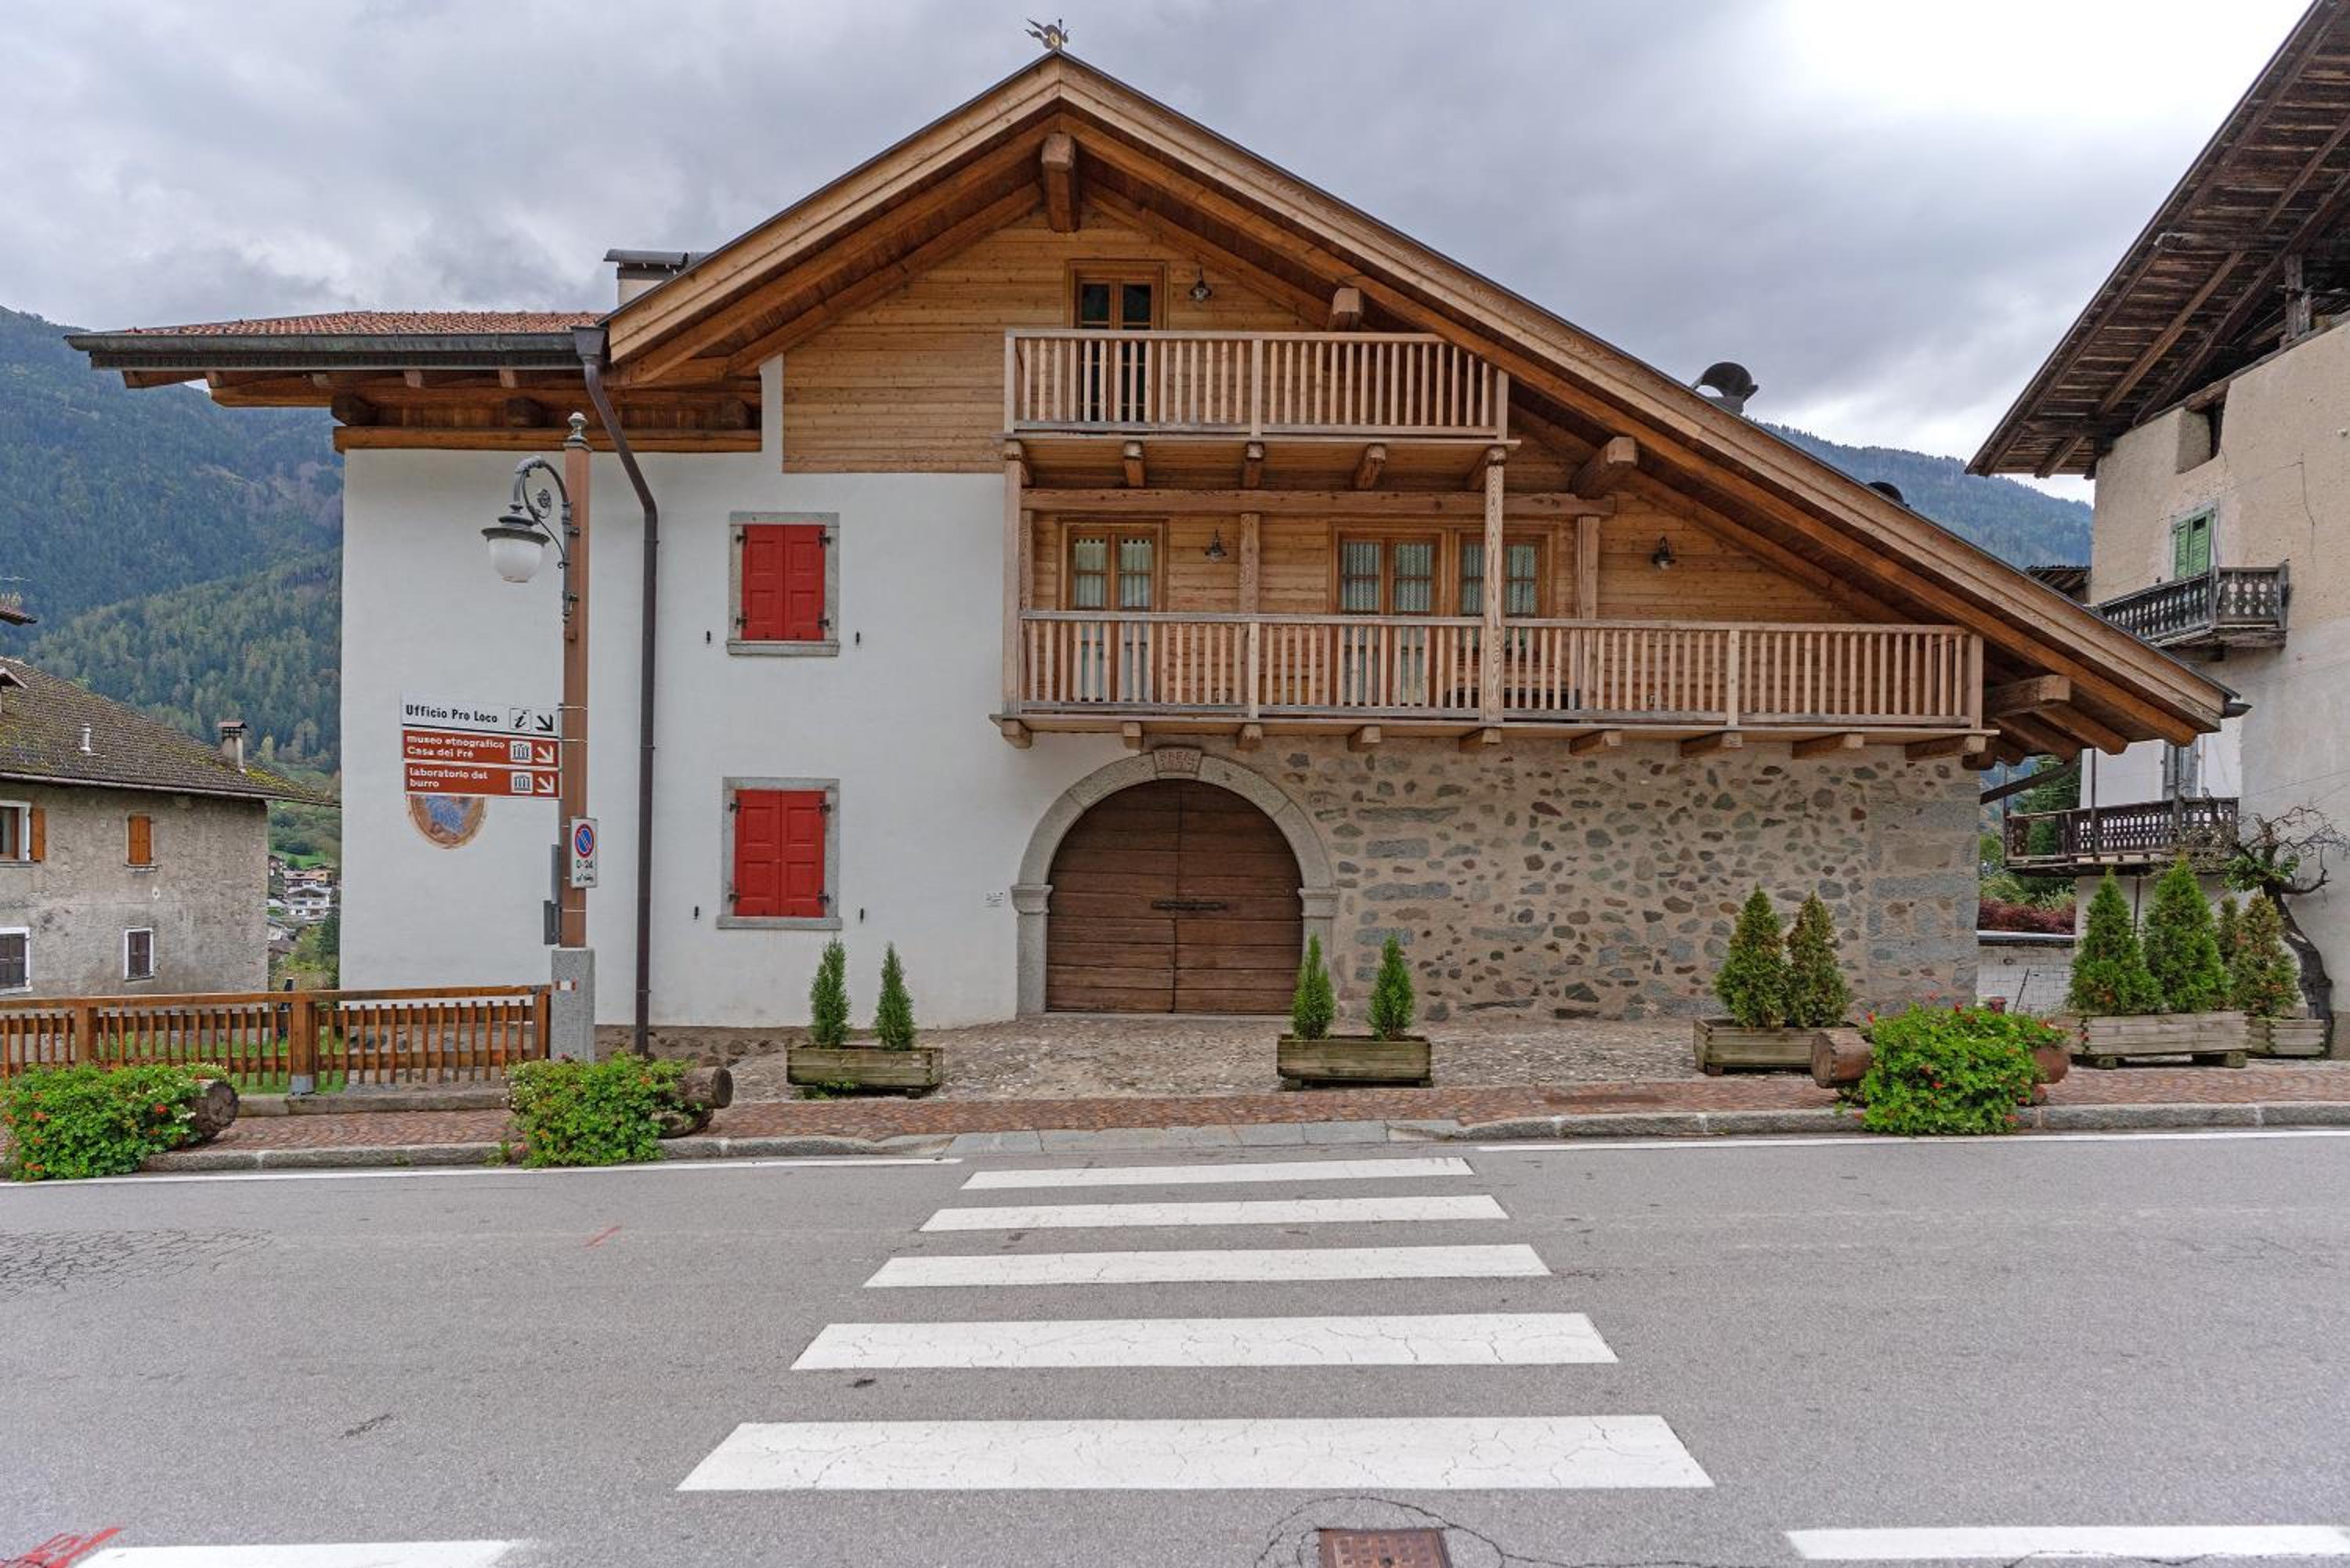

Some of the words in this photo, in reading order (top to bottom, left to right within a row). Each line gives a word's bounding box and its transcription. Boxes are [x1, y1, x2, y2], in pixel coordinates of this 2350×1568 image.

[406, 705, 447, 718] Ufficio
[452, 709, 470, 720] Pro
[474, 711, 497, 722] Loco
[407, 736, 443, 745] museo
[445, 738, 505, 749] etnografico
[407, 746, 434, 756] Casa
[438, 749, 454, 757] del
[471, 771, 488, 779] del
[410, 779, 439, 787] burro
